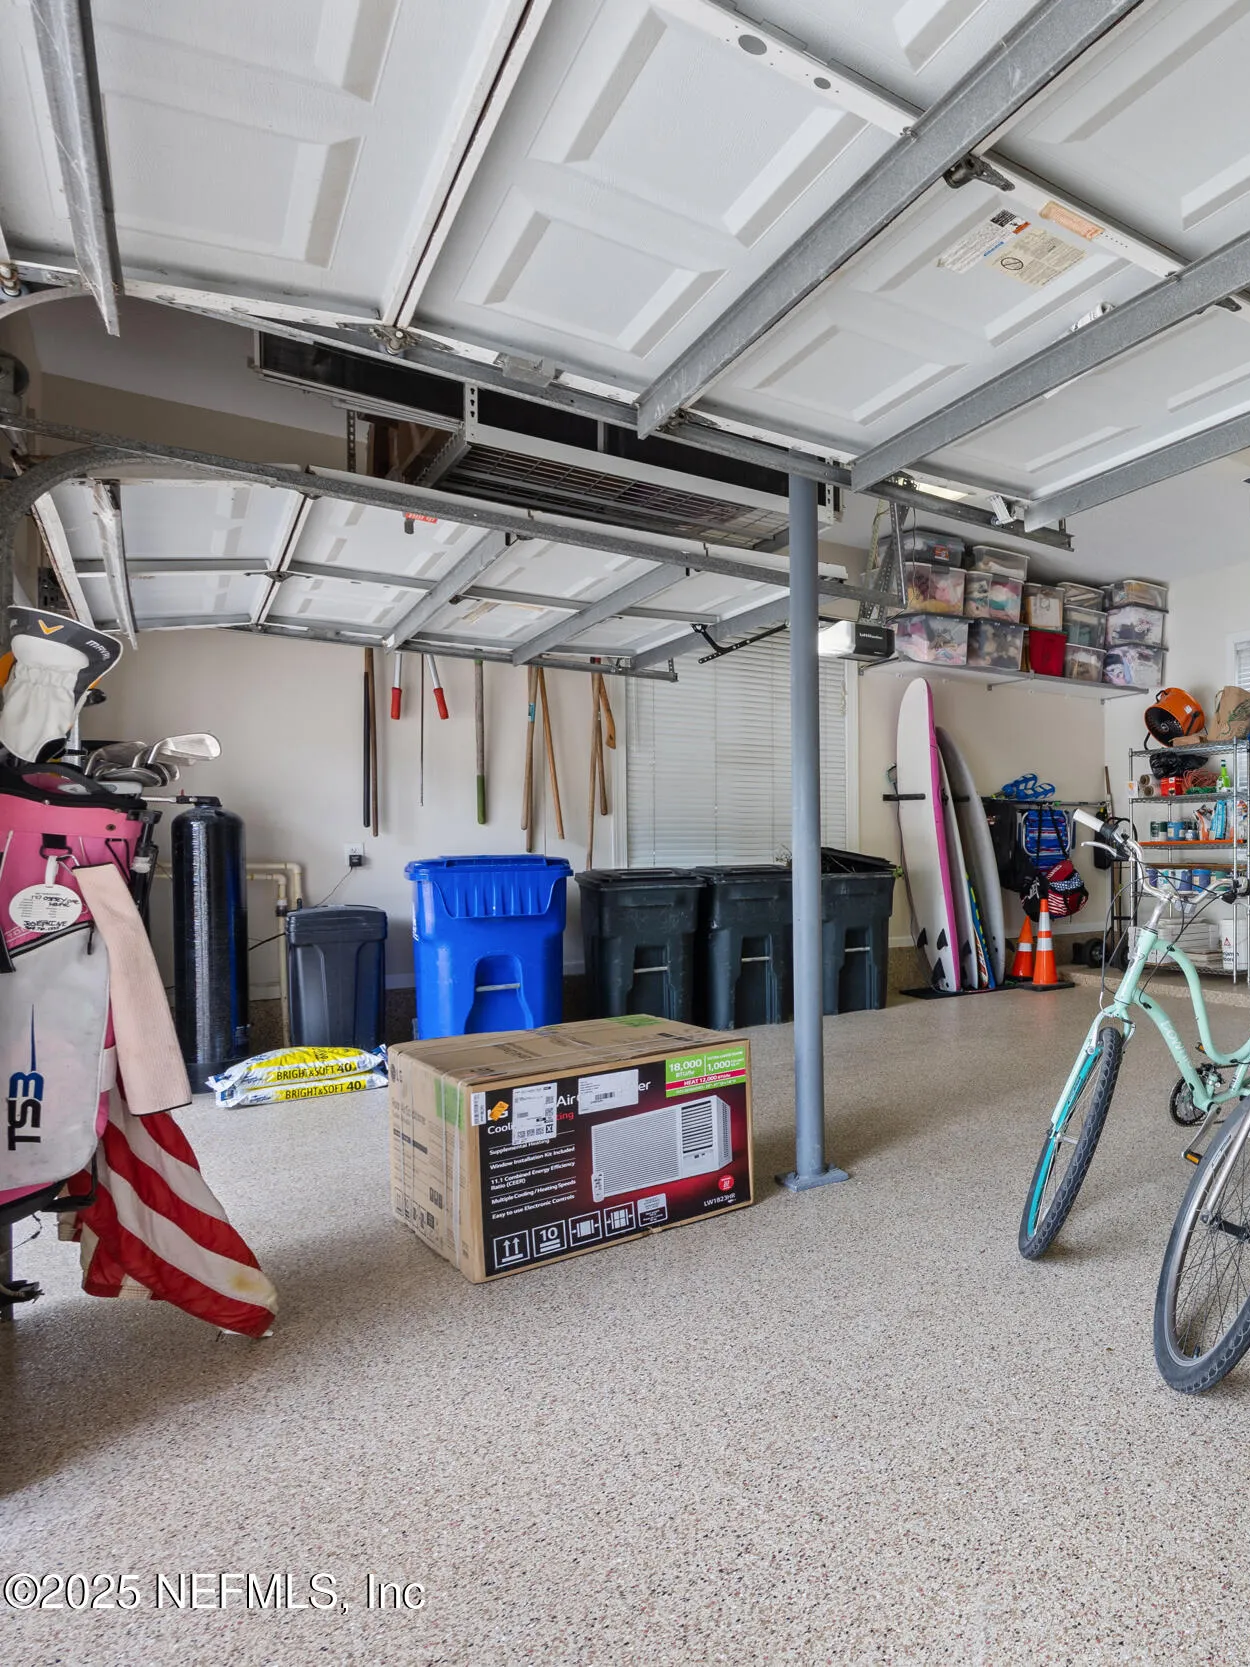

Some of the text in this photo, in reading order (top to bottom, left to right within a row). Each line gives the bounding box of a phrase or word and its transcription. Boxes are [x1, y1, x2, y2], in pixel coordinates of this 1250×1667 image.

[337, 1063, 352, 1073] 40
[669, 1059, 703, 1072] 18,000
[707, 1060, 731, 1072] 1,000
[346, 1081, 361, 1090] 40
[683, 1078, 699, 1086] HEAT
[556, 1094, 576, 1108] Air
[490, 1161, 513, 1170] Window
[513, 1154, 544, 1165] Installation
[553, 1146, 575, 1155] Included
[504, 1171, 531, 1182] Combined
[531, 1167, 550, 1175] Energy
[550, 1161, 576, 1171] Efficiency
[490, 1183, 506, 1191] Ratio
[491, 1195, 514, 1205] Multiple
[557, 1179, 576, 1189] Speeds
[703, 1192, 736, 1207] LW1823HR
[492, 1212, 505, 1221] Easy
[524, 1200, 551, 1211] Electronic
[551, 1194, 575, 1204] Controls
[538, 1226, 558, 1241] 10
